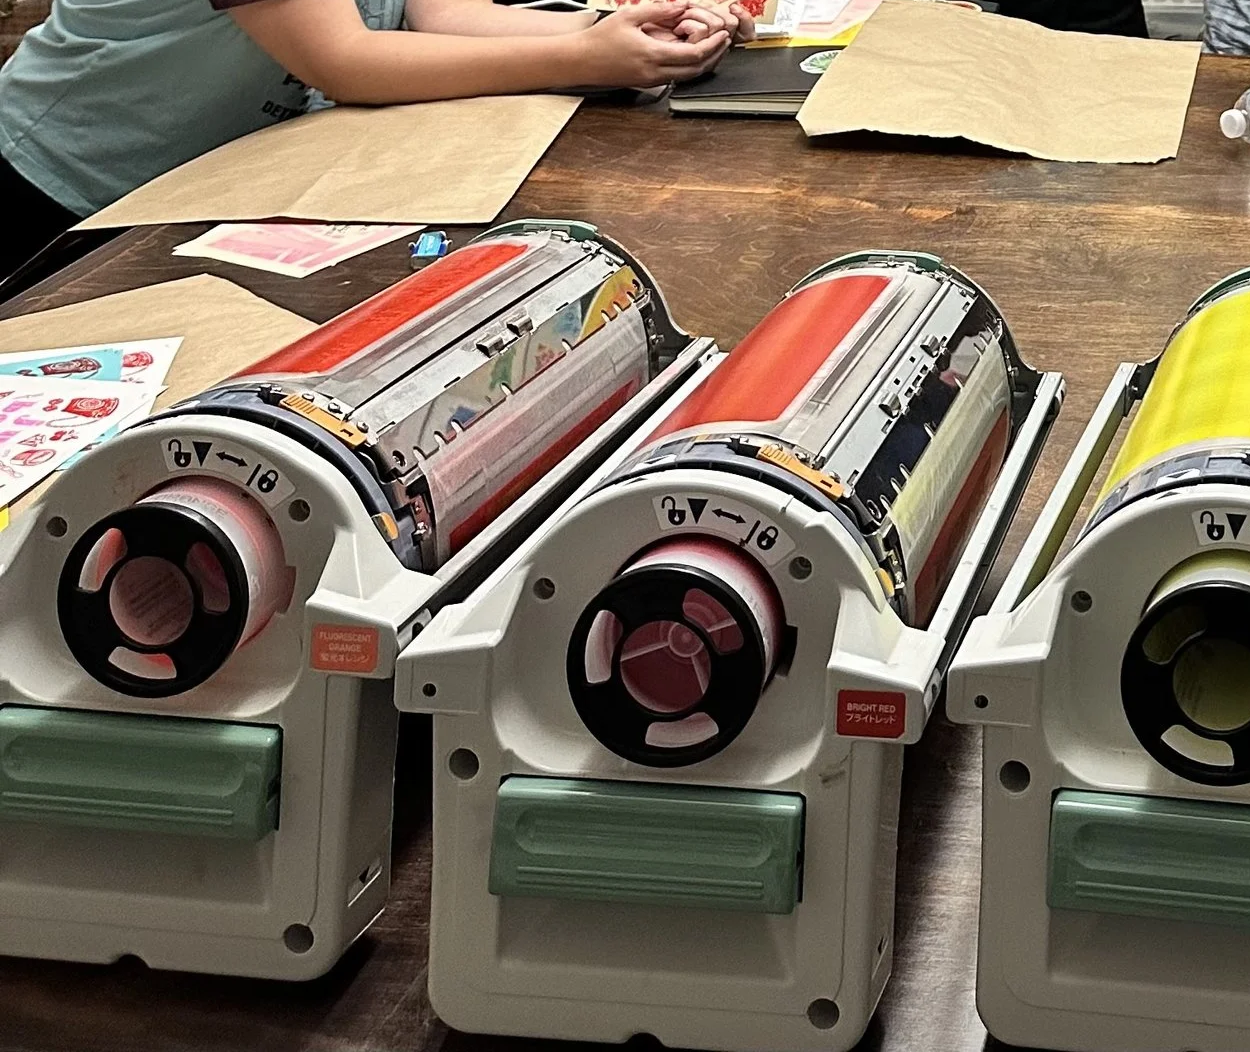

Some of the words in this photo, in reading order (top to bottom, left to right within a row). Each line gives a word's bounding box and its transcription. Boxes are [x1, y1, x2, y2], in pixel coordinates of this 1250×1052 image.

[320, 632, 371, 643] FLUORESCENT
[329, 643, 361, 652] ORANGE
[847, 703, 877, 712] BRIGHT
[878, 704, 896, 713] RED
